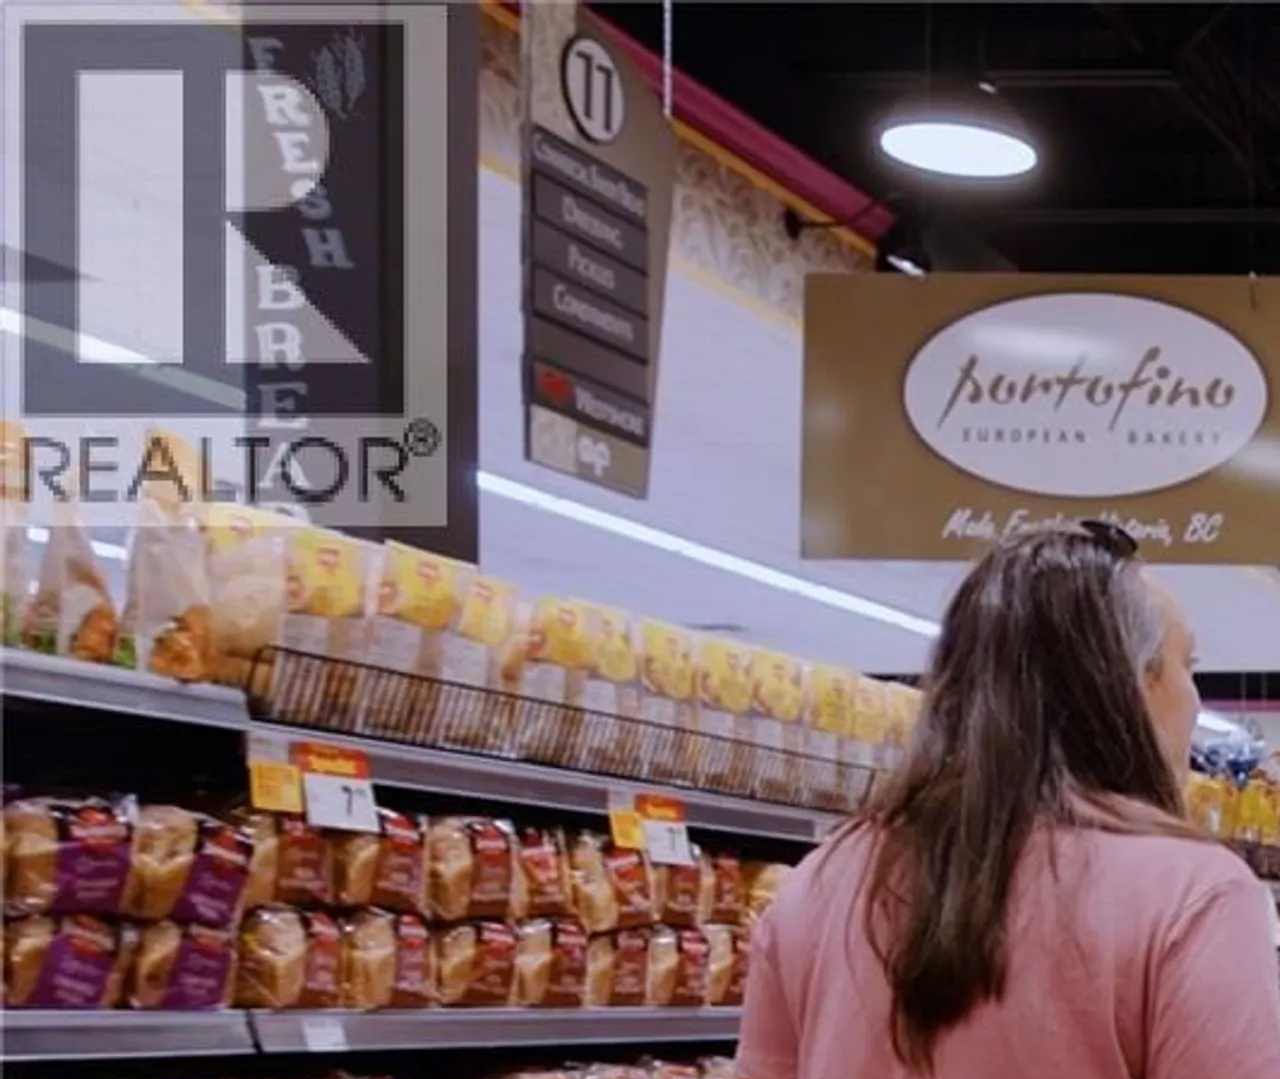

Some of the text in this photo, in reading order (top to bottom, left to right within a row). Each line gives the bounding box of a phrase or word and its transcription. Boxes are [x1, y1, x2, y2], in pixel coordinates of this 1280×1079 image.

[576, 51, 615, 134] 11
[935, 346, 1235, 432] portofino
[962, 427, 1222, 446] EUROPEAN BAKERY
[1183, 510, 1225, 544] BC
